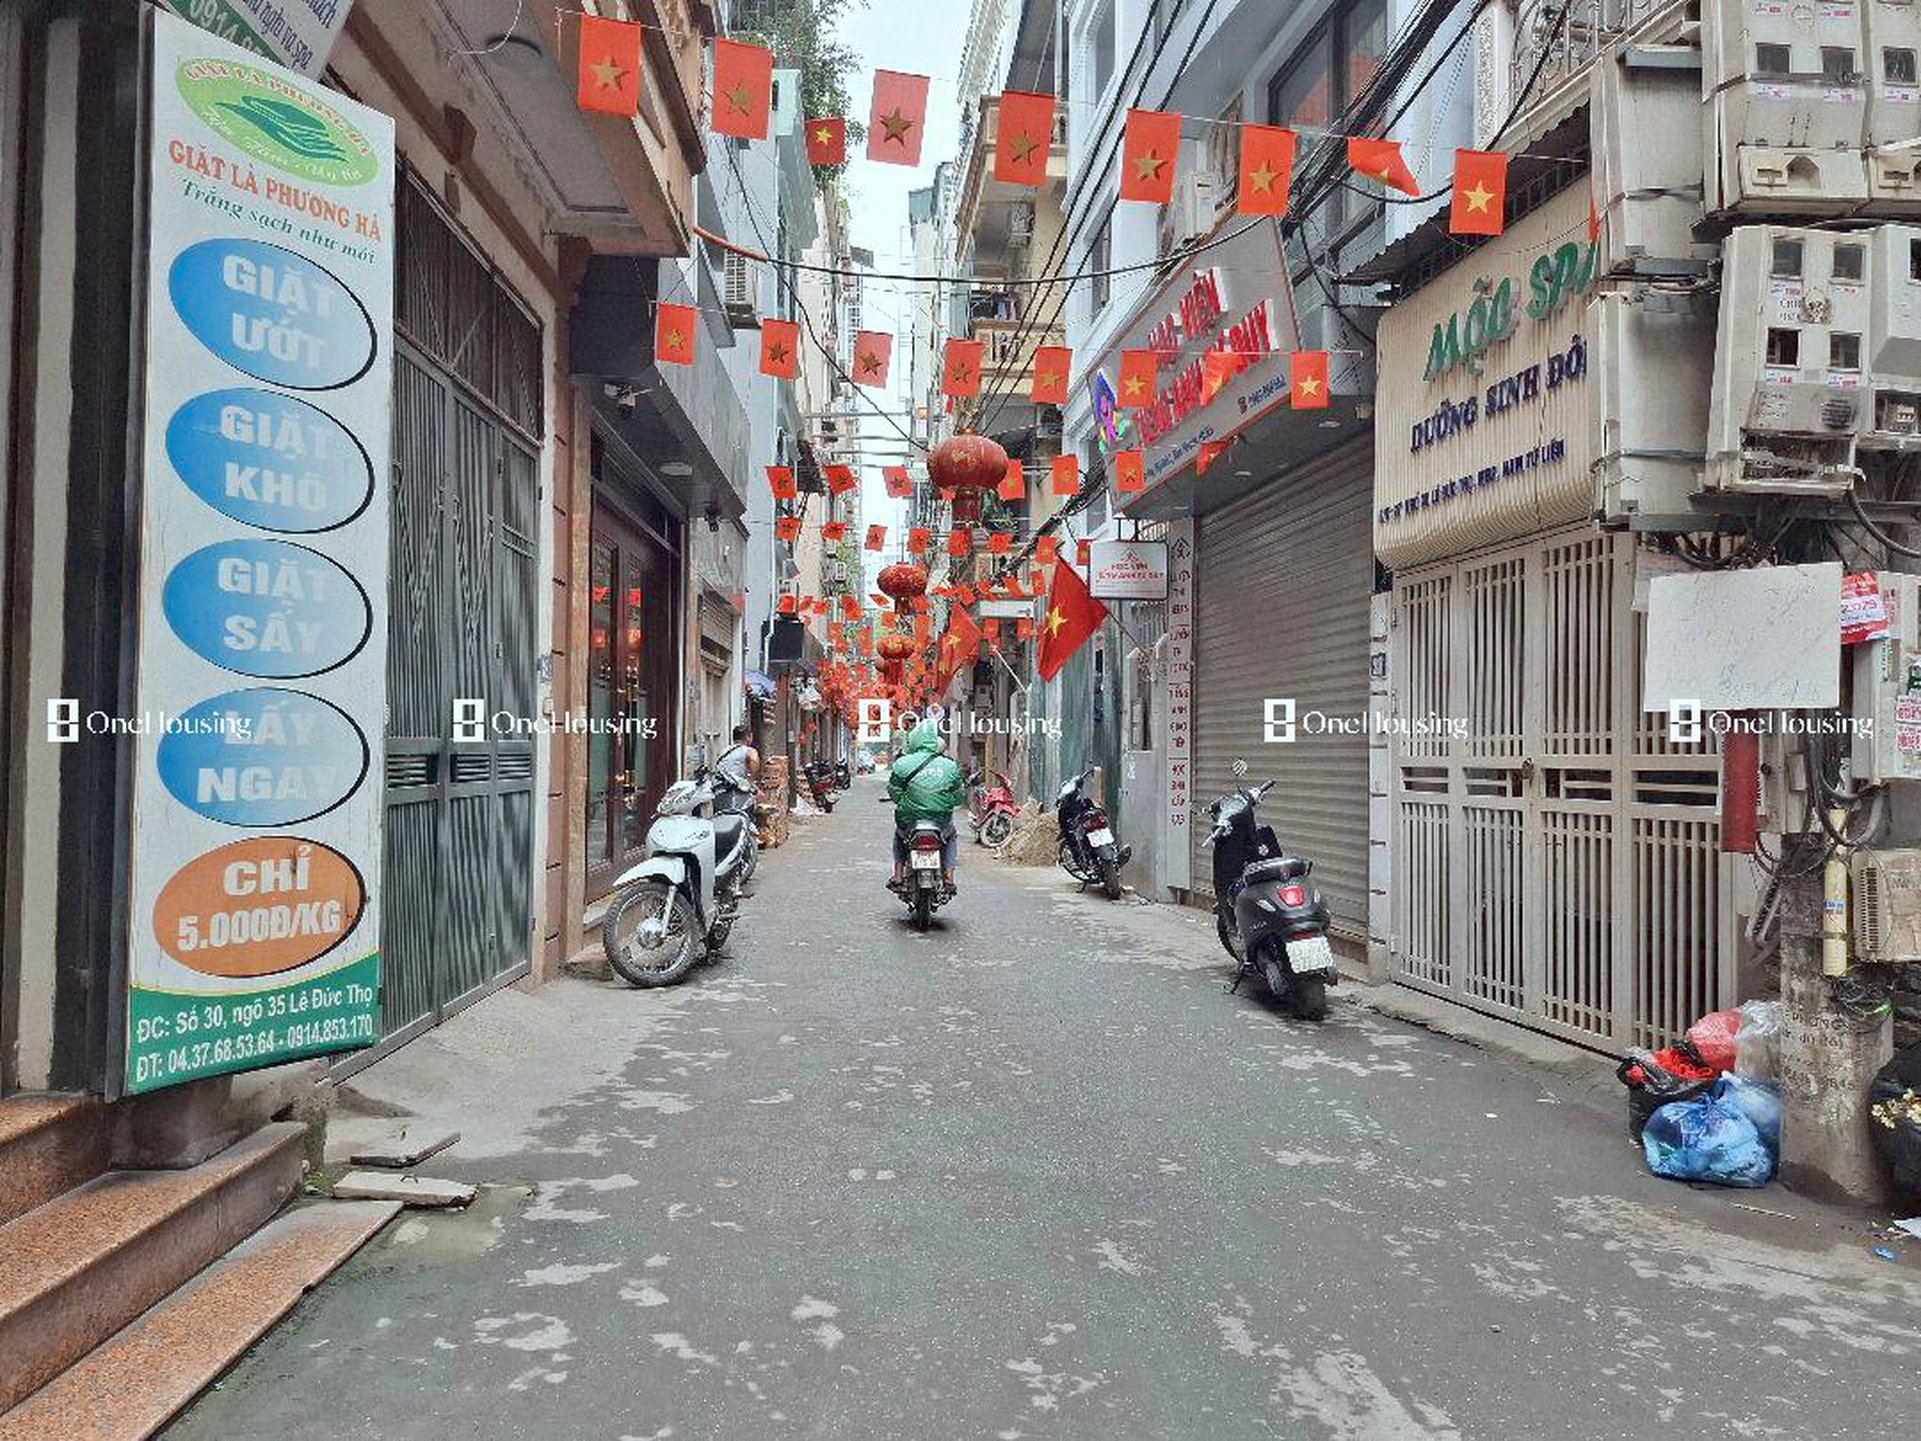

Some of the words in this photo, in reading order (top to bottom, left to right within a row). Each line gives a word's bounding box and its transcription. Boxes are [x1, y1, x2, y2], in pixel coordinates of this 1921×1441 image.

[169, 139, 225, 180] GIẶT
[231, 163, 258, 196] LÀ
[266, 177, 350, 229] PHƯƠNG
[182, 178, 243, 219] Trắng
[249, 206, 293, 234] sạch
[341, 243, 375, 264] mới
[222, 254, 337, 317] GIẶT
[231, 312, 326, 369] ƯỚT
[1422, 275, 1515, 382] MỘC
[220, 405, 334, 460] GIẶT
[1410, 395, 1480, 454] DƯỠNG
[1485, 363, 1541, 417] SINH
[225, 461, 328, 513] KHÔ
[217, 557, 334, 606] GIẶT
[223, 607, 325, 654] SẤY
[198, 766, 337, 804] NGAY
[223, 844, 312, 896] CHỈ
[177, 900, 342, 952] 5.000Đ/KG
[136, 1014, 170, 1043] ĐC:
[176, 1005, 199, 1035] Số
[203, 1004, 227, 1030] 30,
[232, 1001, 263, 1028] ngõ
[267, 995, 286, 1017] 35
[289, 990, 309, 1014] Lê
[311, 988, 343, 1010] Đức
[347, 983, 373, 1008] Thọ
[136, 1052, 164, 1083] ĐT:
[168, 1029, 275, 1075] 04.37.68.53.64
[287, 1014, 373, 1049] 0914.853.170
